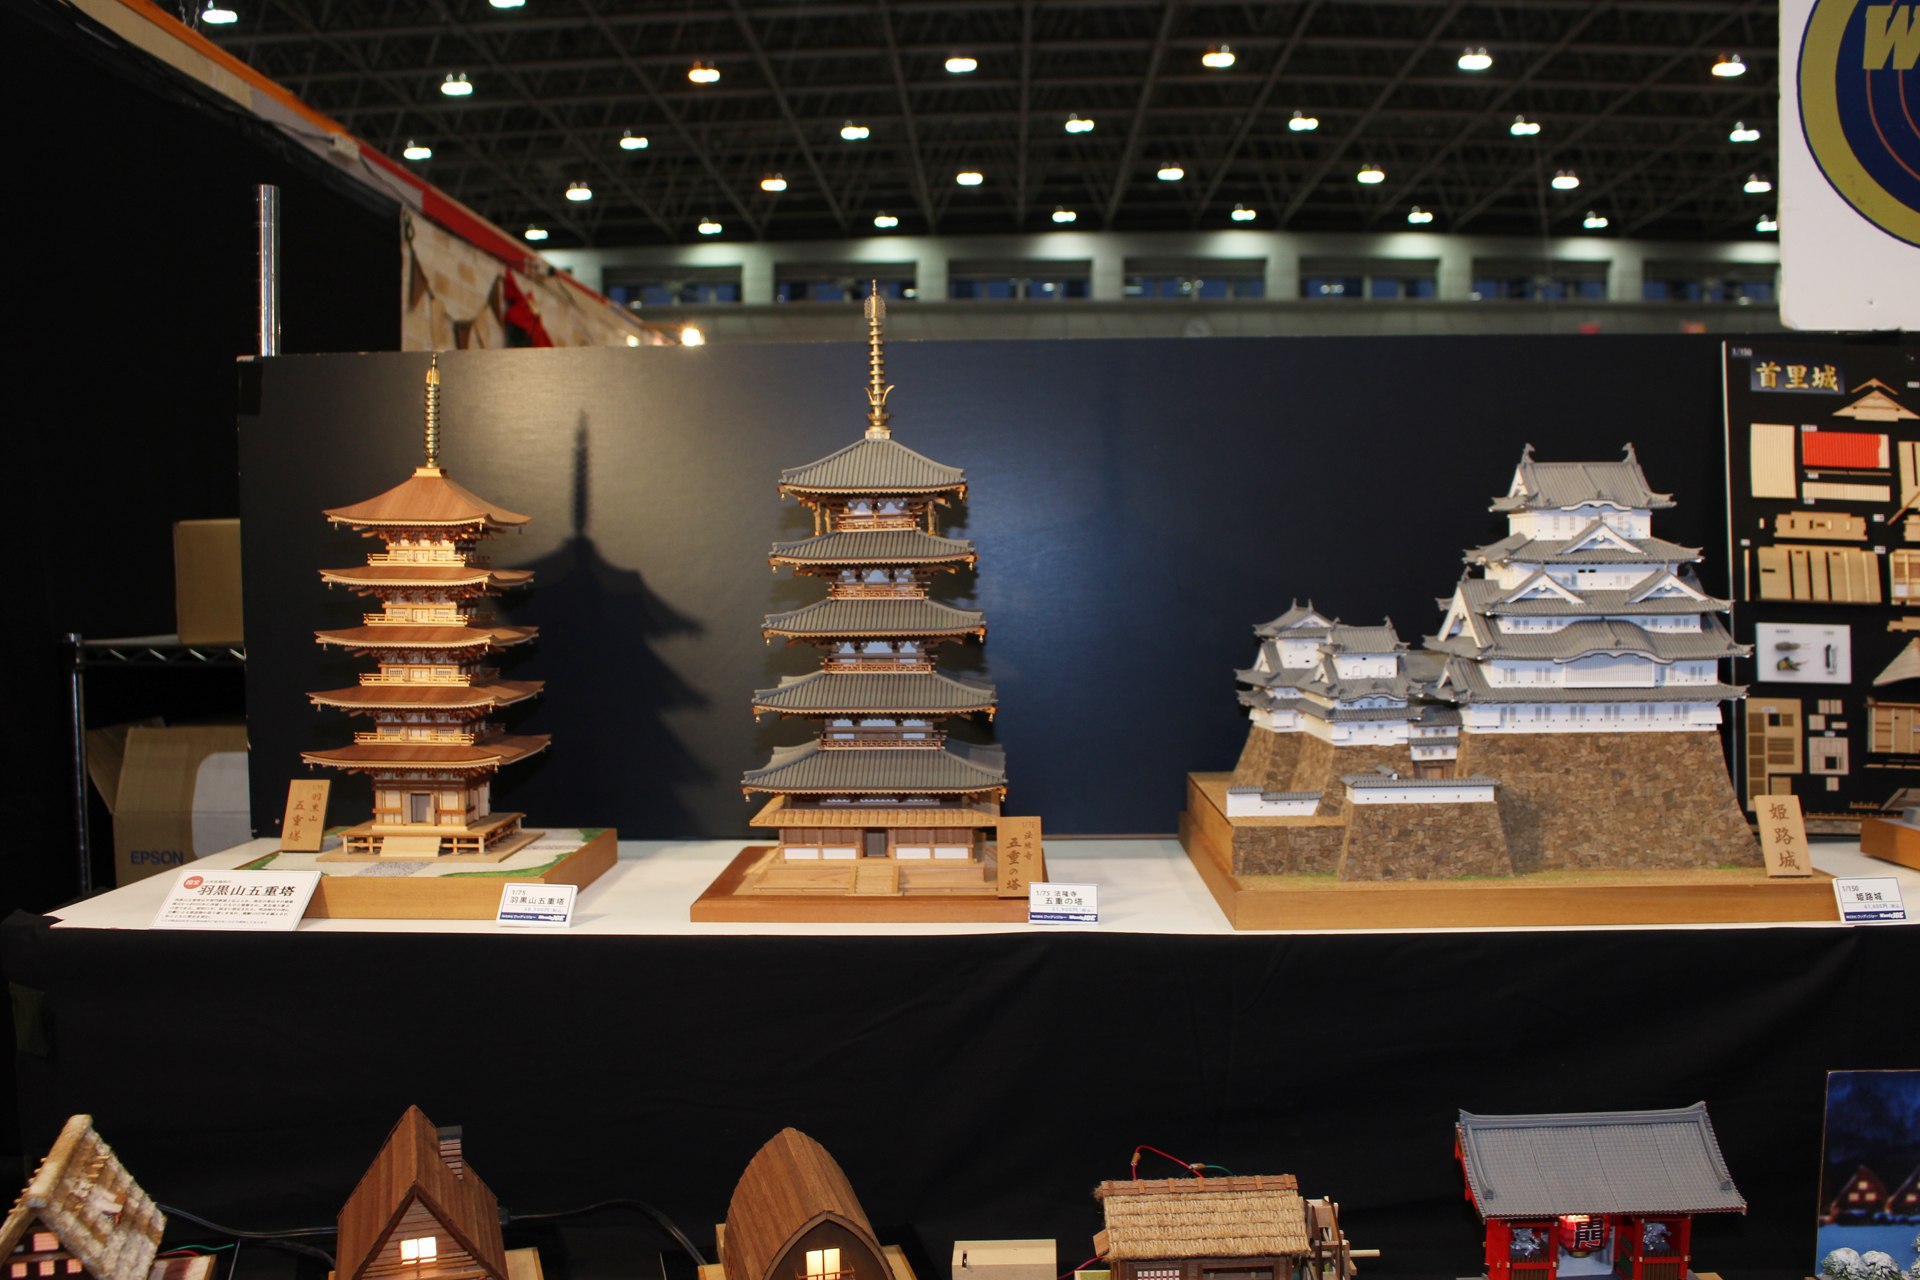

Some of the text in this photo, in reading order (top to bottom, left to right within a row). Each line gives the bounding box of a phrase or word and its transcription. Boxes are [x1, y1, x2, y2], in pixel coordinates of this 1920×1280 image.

[1755, 361, 1839, 392] 首里城
[287, 799, 305, 842] 五重塔
[1768, 802, 1800, 871] 姫路城
[130, 850, 184, 865] EPSON
[1006, 837, 1022, 890] 五重の塔
[197, 885, 296, 897] 羽黒山五重塔
[1856, 892, 1883, 901] 姫路城
[510, 896, 565, 905] 羽黒山五重塔
[1045, 897, 1083, 905] 五重の塔
